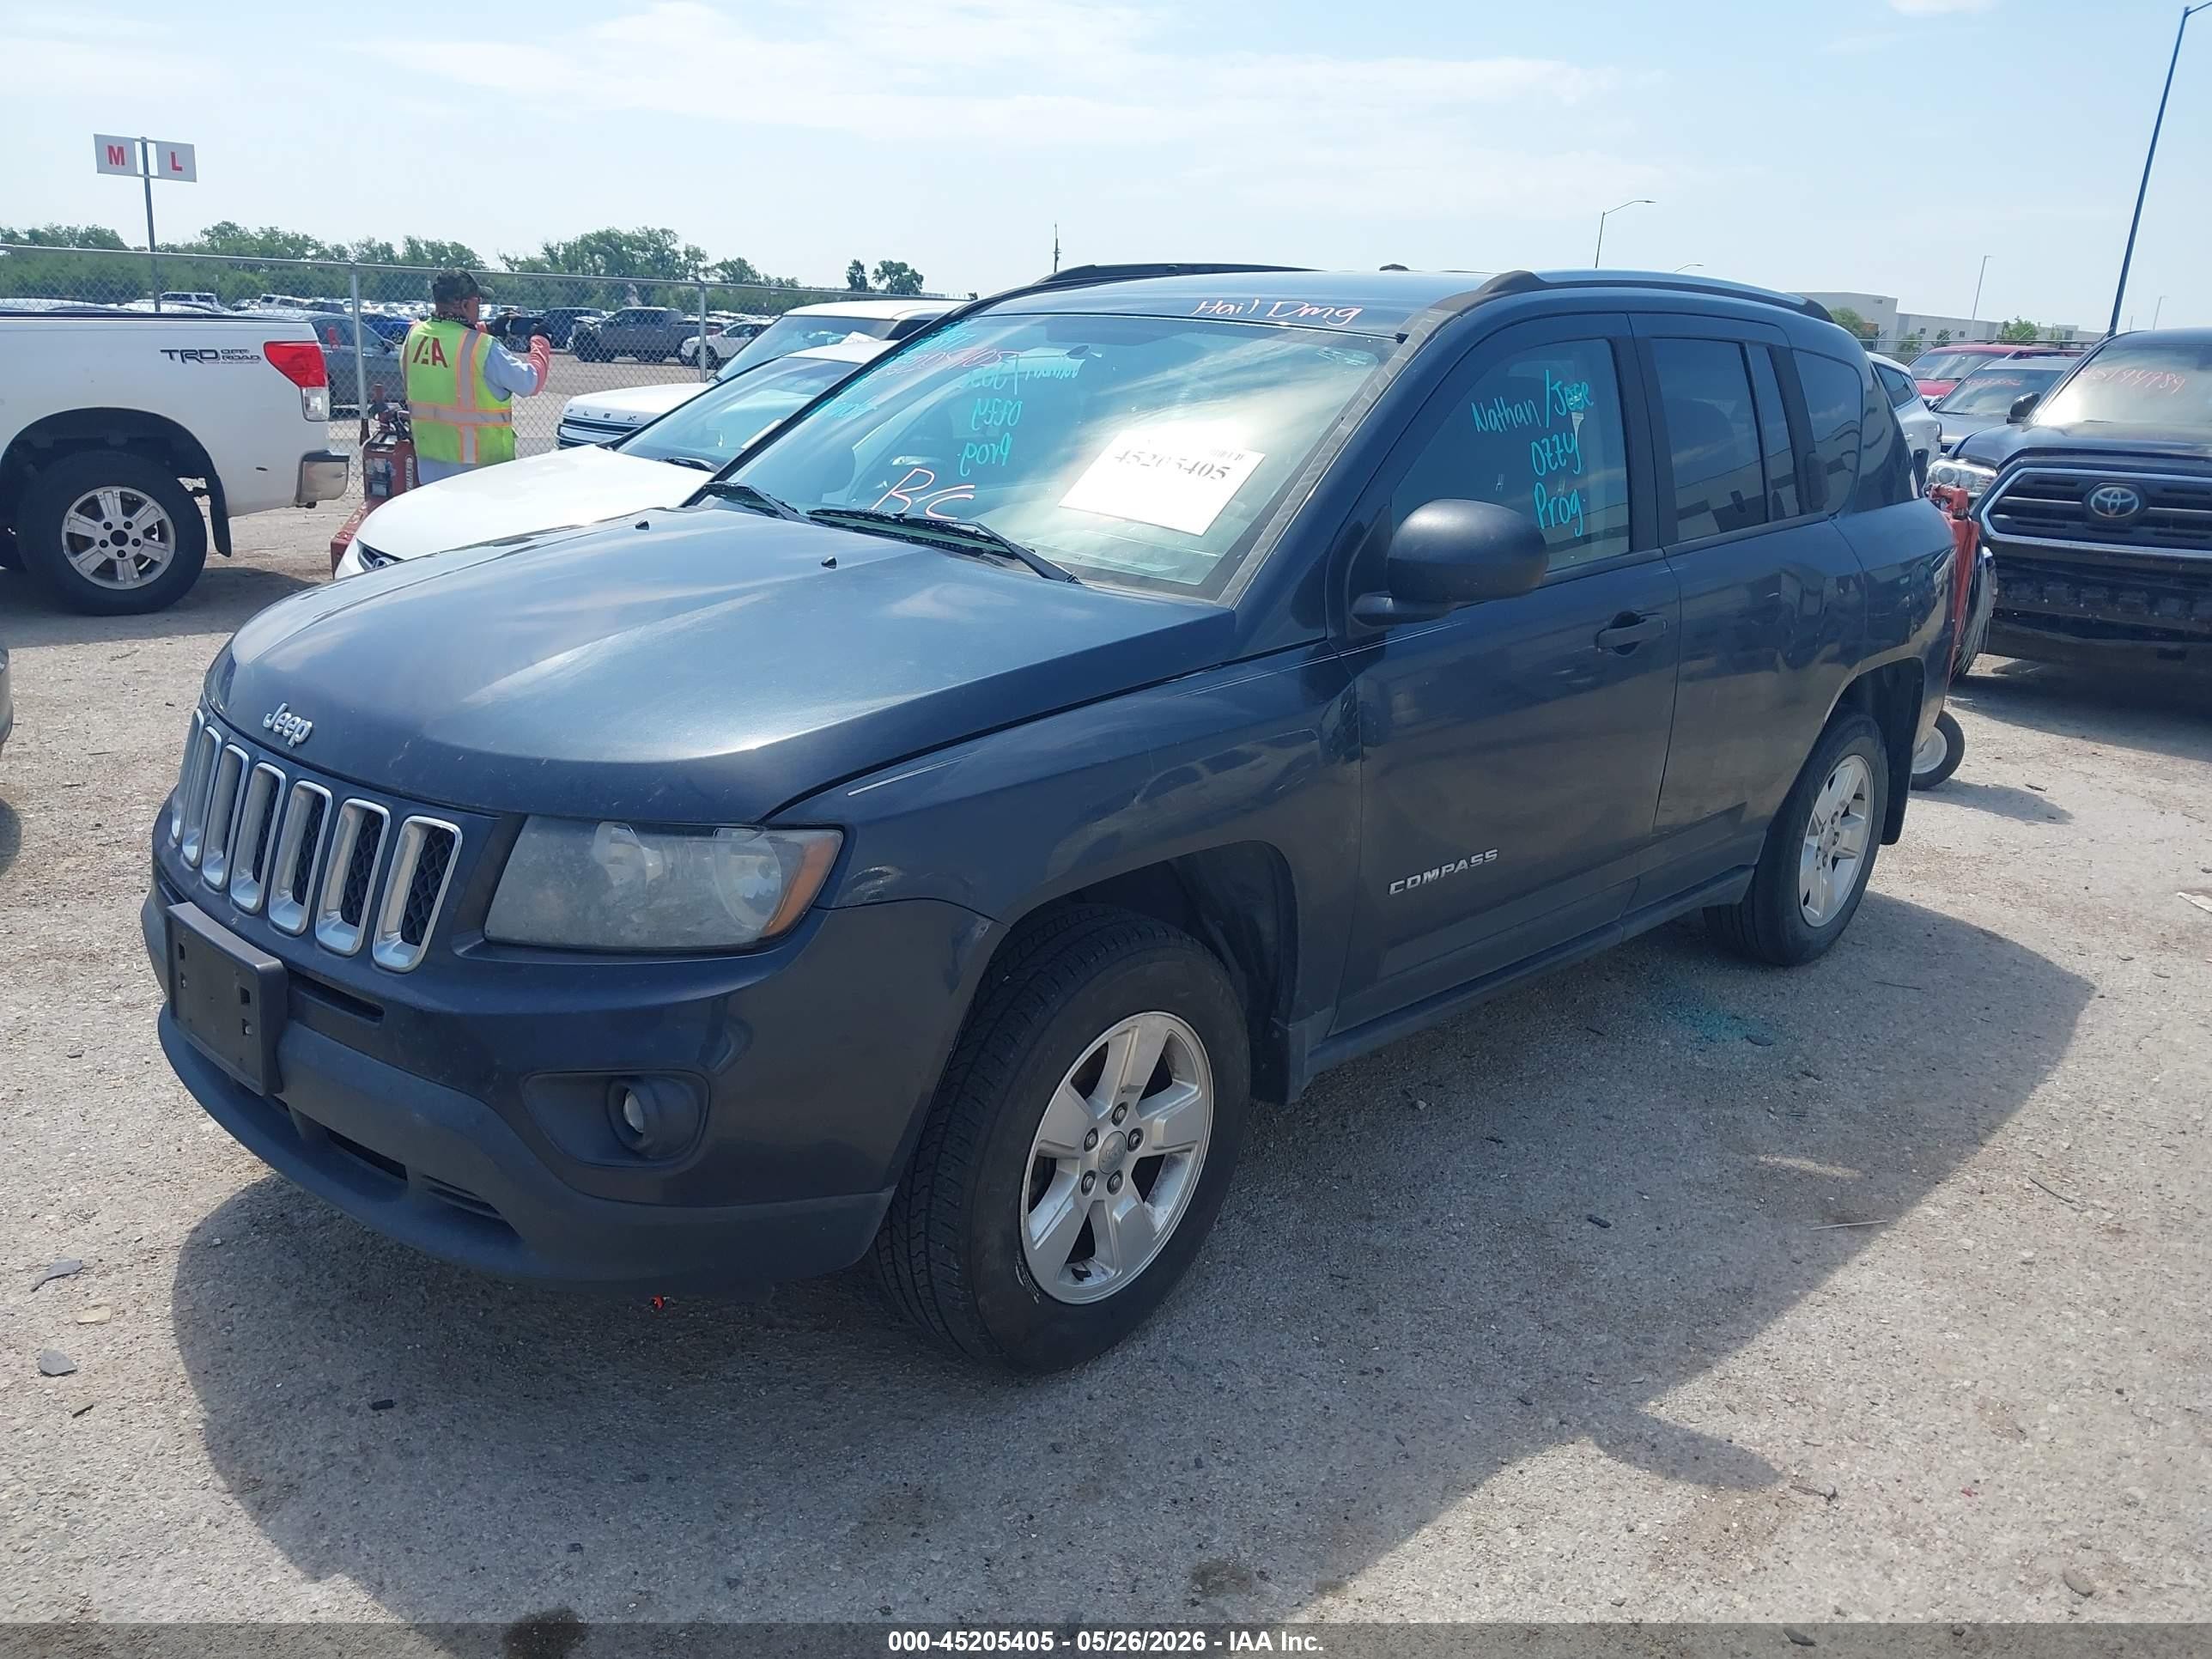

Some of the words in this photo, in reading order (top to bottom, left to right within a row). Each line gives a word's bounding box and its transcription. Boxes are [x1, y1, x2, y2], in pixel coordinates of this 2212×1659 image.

[107, 145, 125, 166] M
[170, 151, 183, 172] L
[1191, 298, 1260, 316] Hail
[1266, 301, 1364, 326] Dmg
[160, 349, 220, 364] TRD
[263, 702, 313, 748] Jeep
[1389, 848, 1498, 895] COMPASS
